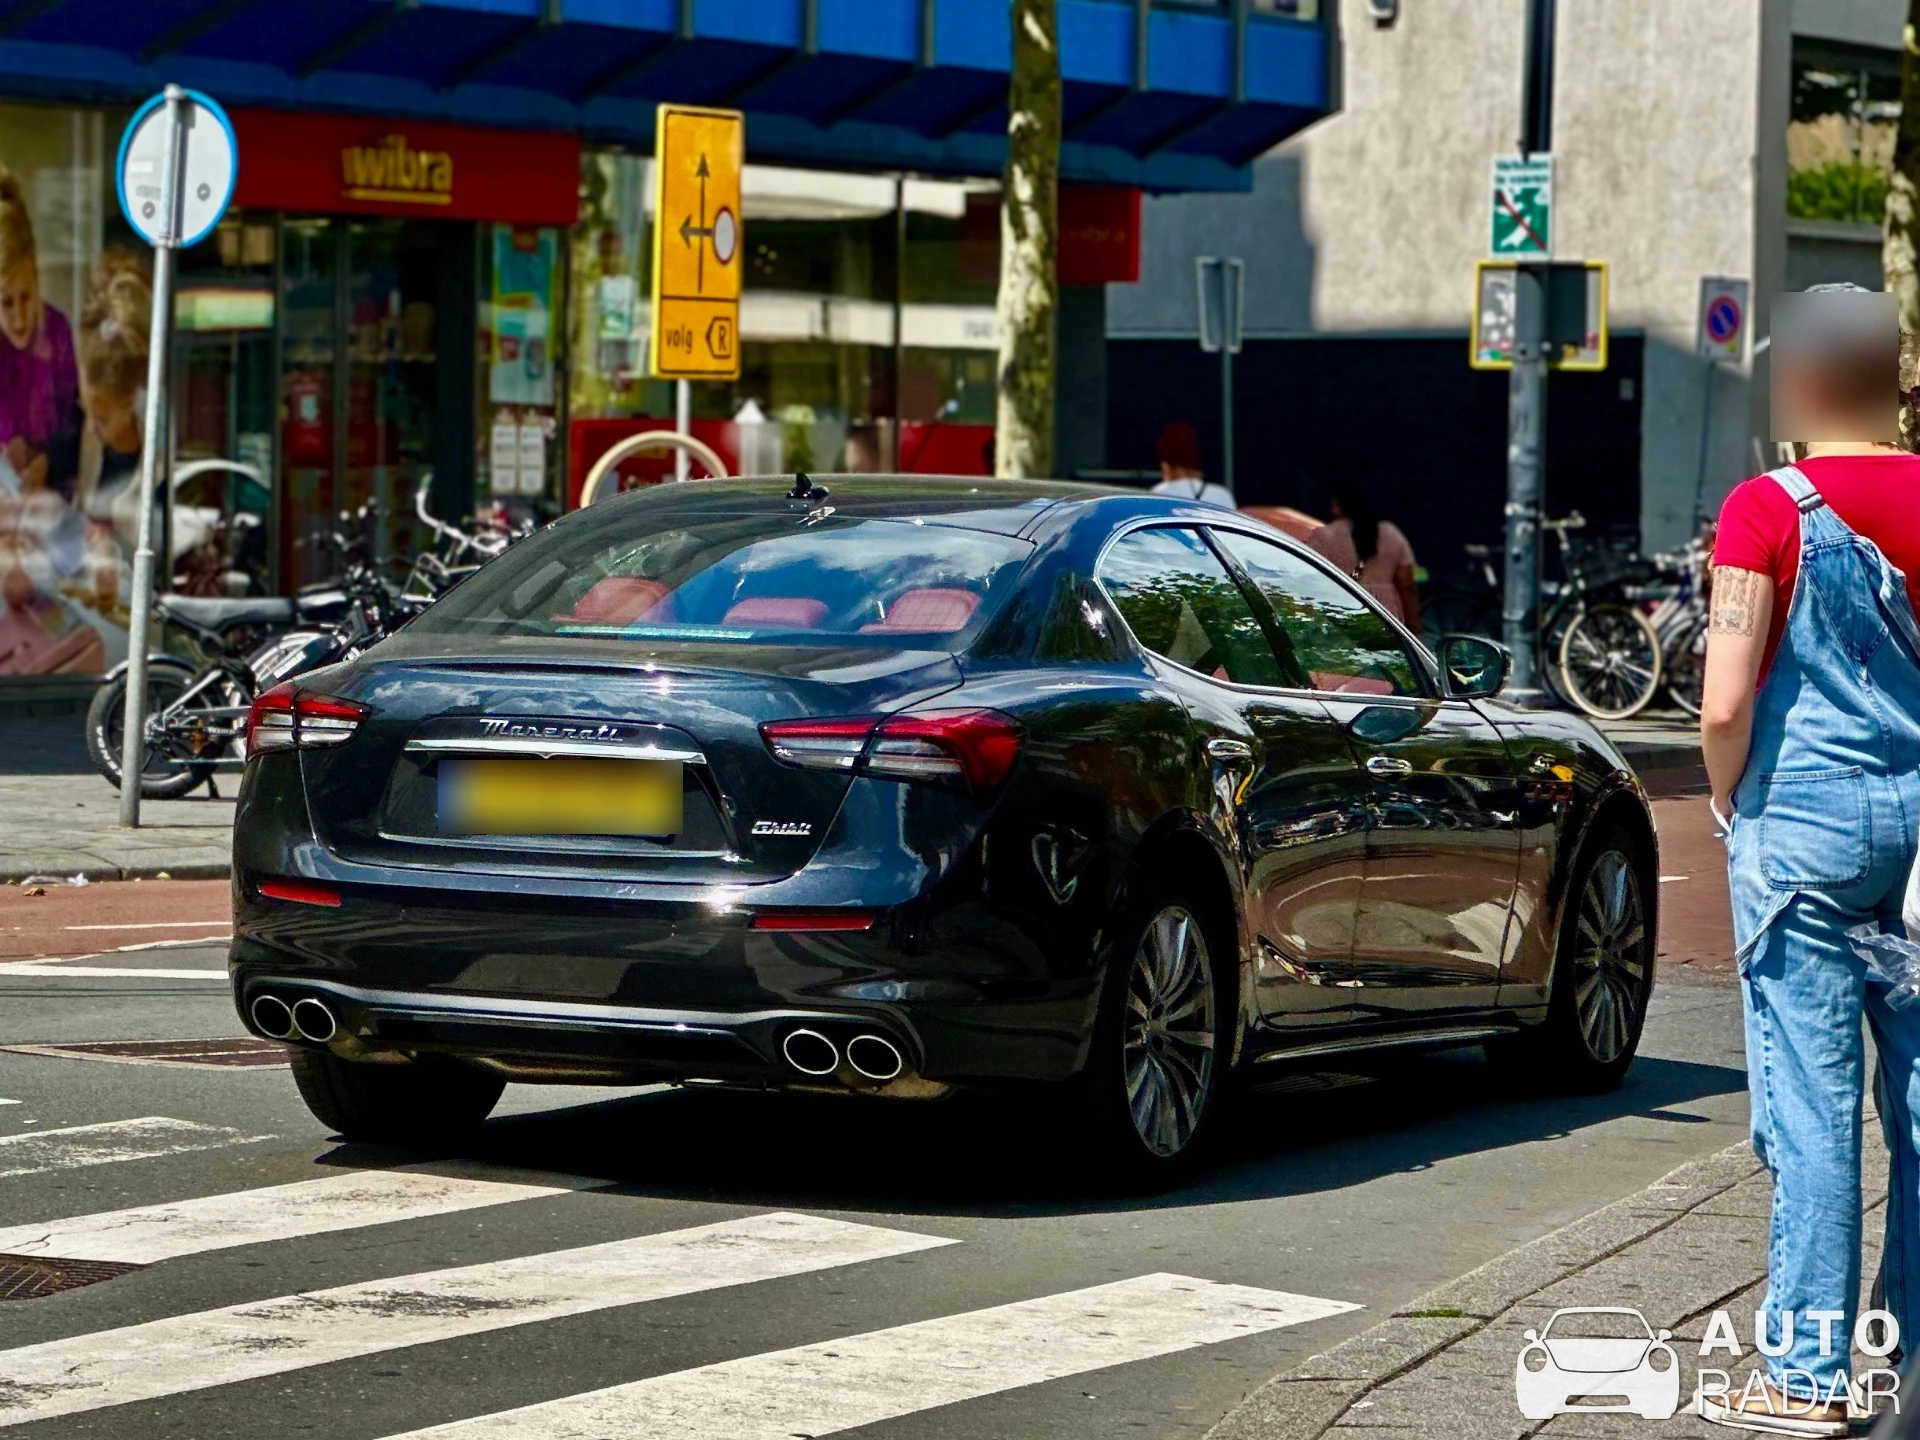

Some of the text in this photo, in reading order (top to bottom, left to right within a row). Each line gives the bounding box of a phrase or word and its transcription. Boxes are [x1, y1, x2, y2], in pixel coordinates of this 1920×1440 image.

[341, 133, 453, 192] wibra
[666, 324, 727, 354] volg R
[479, 718, 624, 742] Maserati
[751, 820, 812, 836] Ghibli
